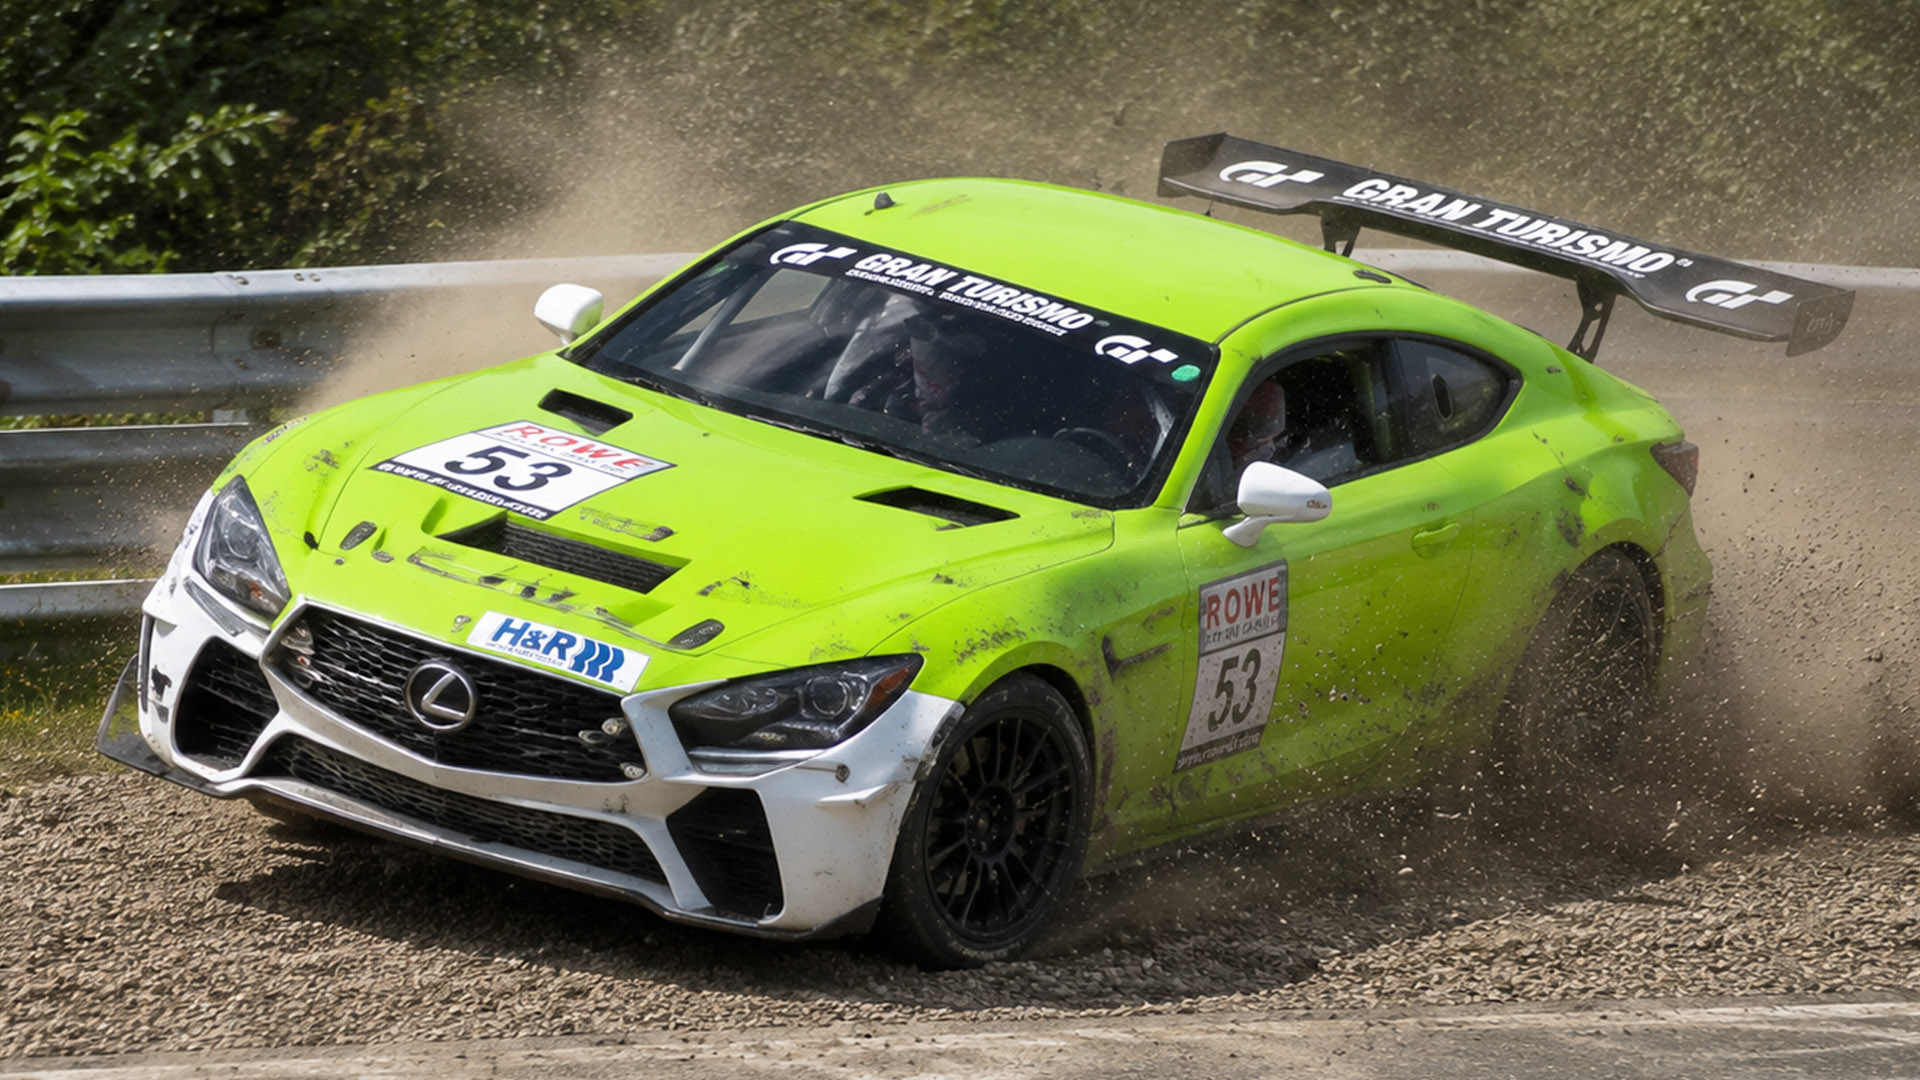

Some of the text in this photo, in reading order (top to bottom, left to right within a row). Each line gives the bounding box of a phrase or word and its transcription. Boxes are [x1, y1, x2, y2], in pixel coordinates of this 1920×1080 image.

[1342, 179, 1482, 221] GRAN
[1472, 208, 1675, 273] TURISMO
[854, 253, 958, 287] GRAN
[947, 275, 1094, 330] TURISMO
[444, 445, 573, 491] 53
[505, 425, 654, 469] ROWE
[1206, 577, 1280, 629] ROWE
[491, 618, 577, 662] H&R
[1208, 648, 1261, 733] 53
